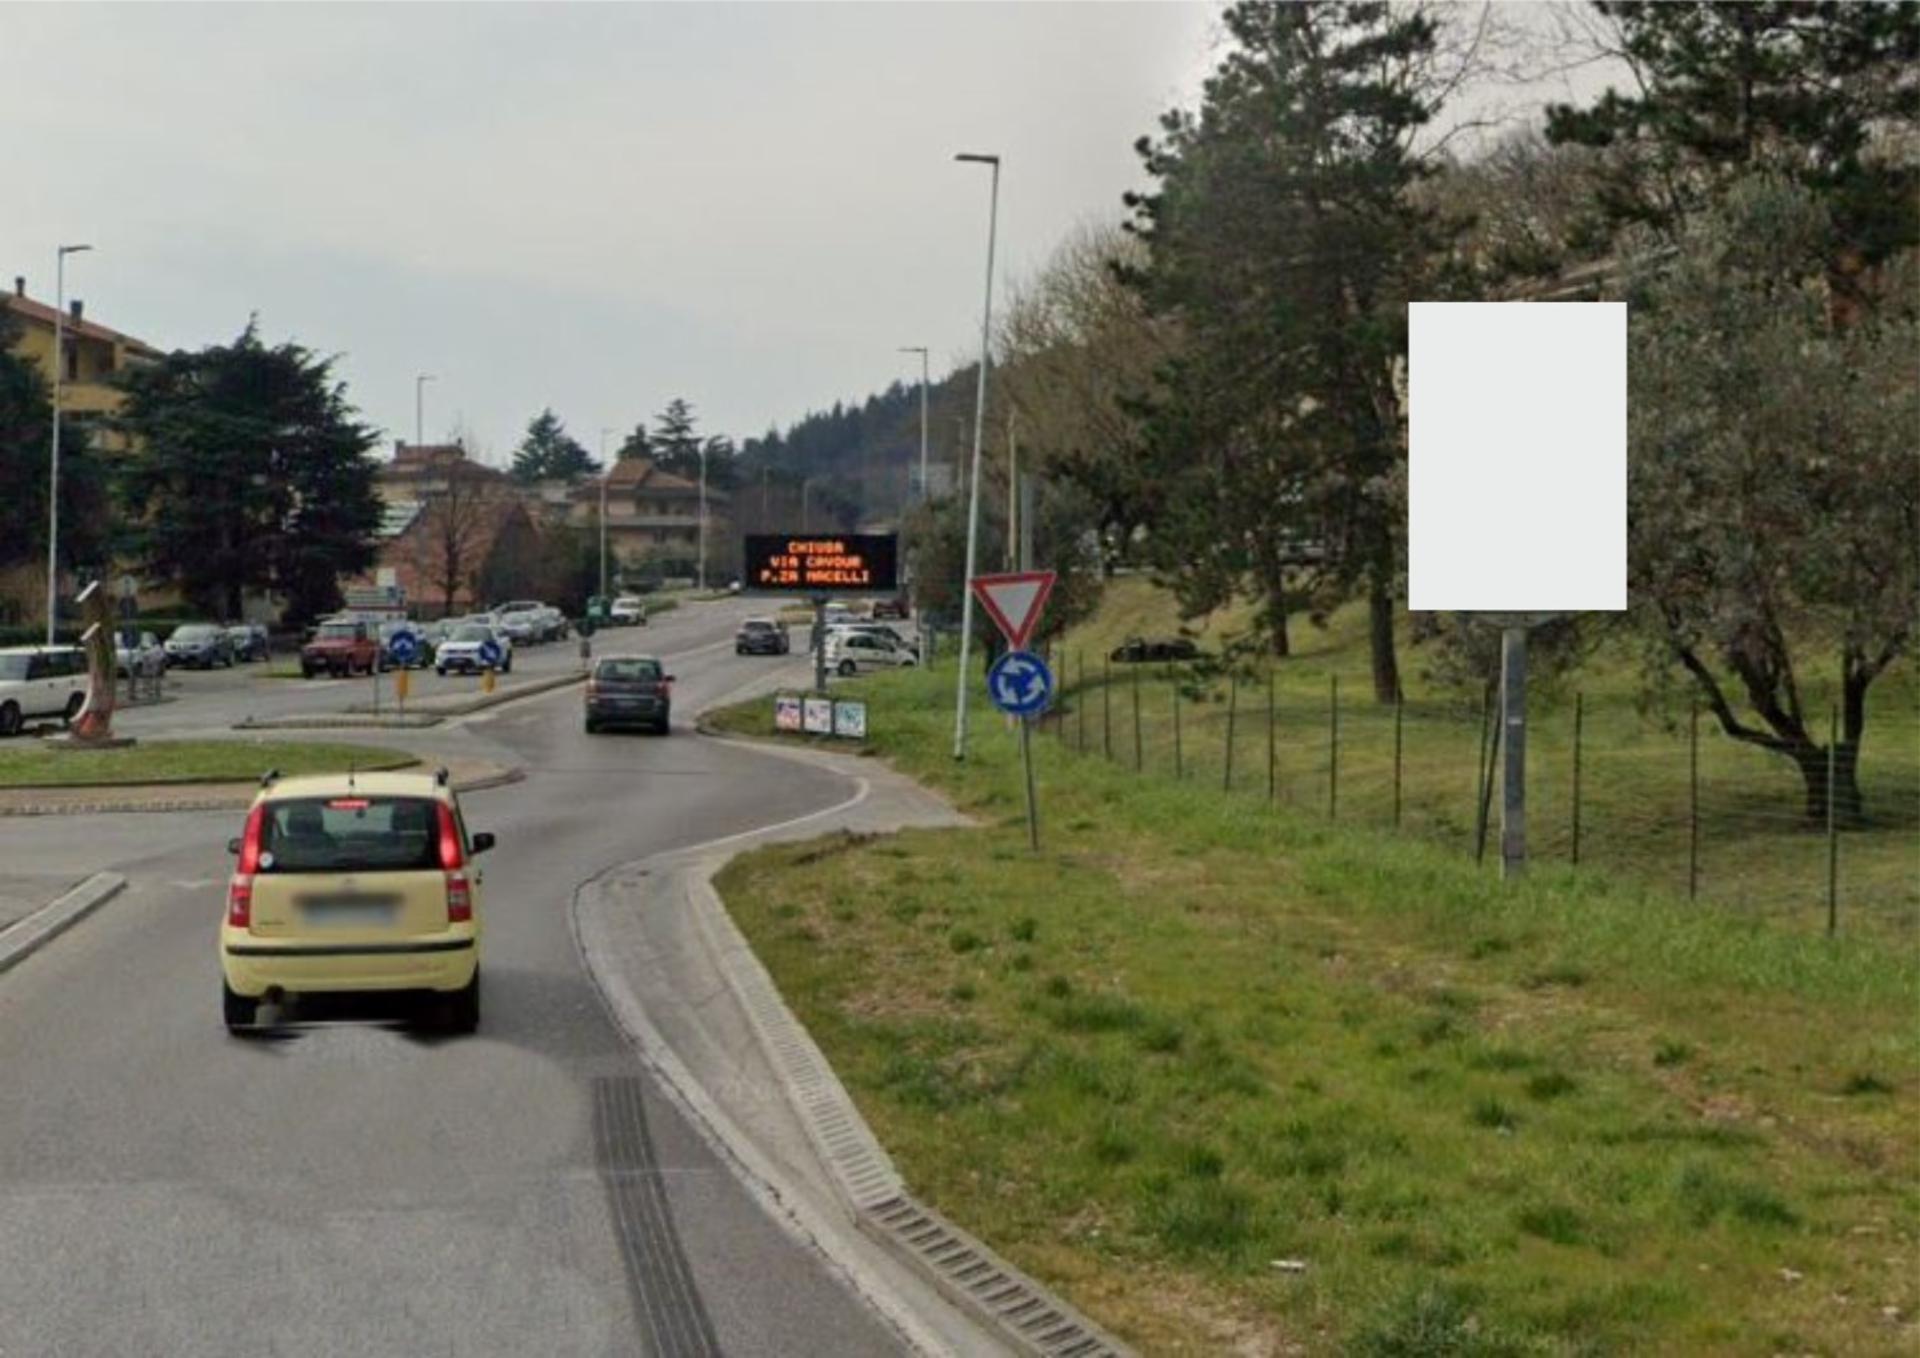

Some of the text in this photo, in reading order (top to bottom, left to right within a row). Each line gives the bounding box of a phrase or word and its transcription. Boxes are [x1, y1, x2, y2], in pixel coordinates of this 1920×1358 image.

[770, 555, 861, 568] VIA CAVOUR
[761, 570, 869, 582] P.ZA MACELLI
